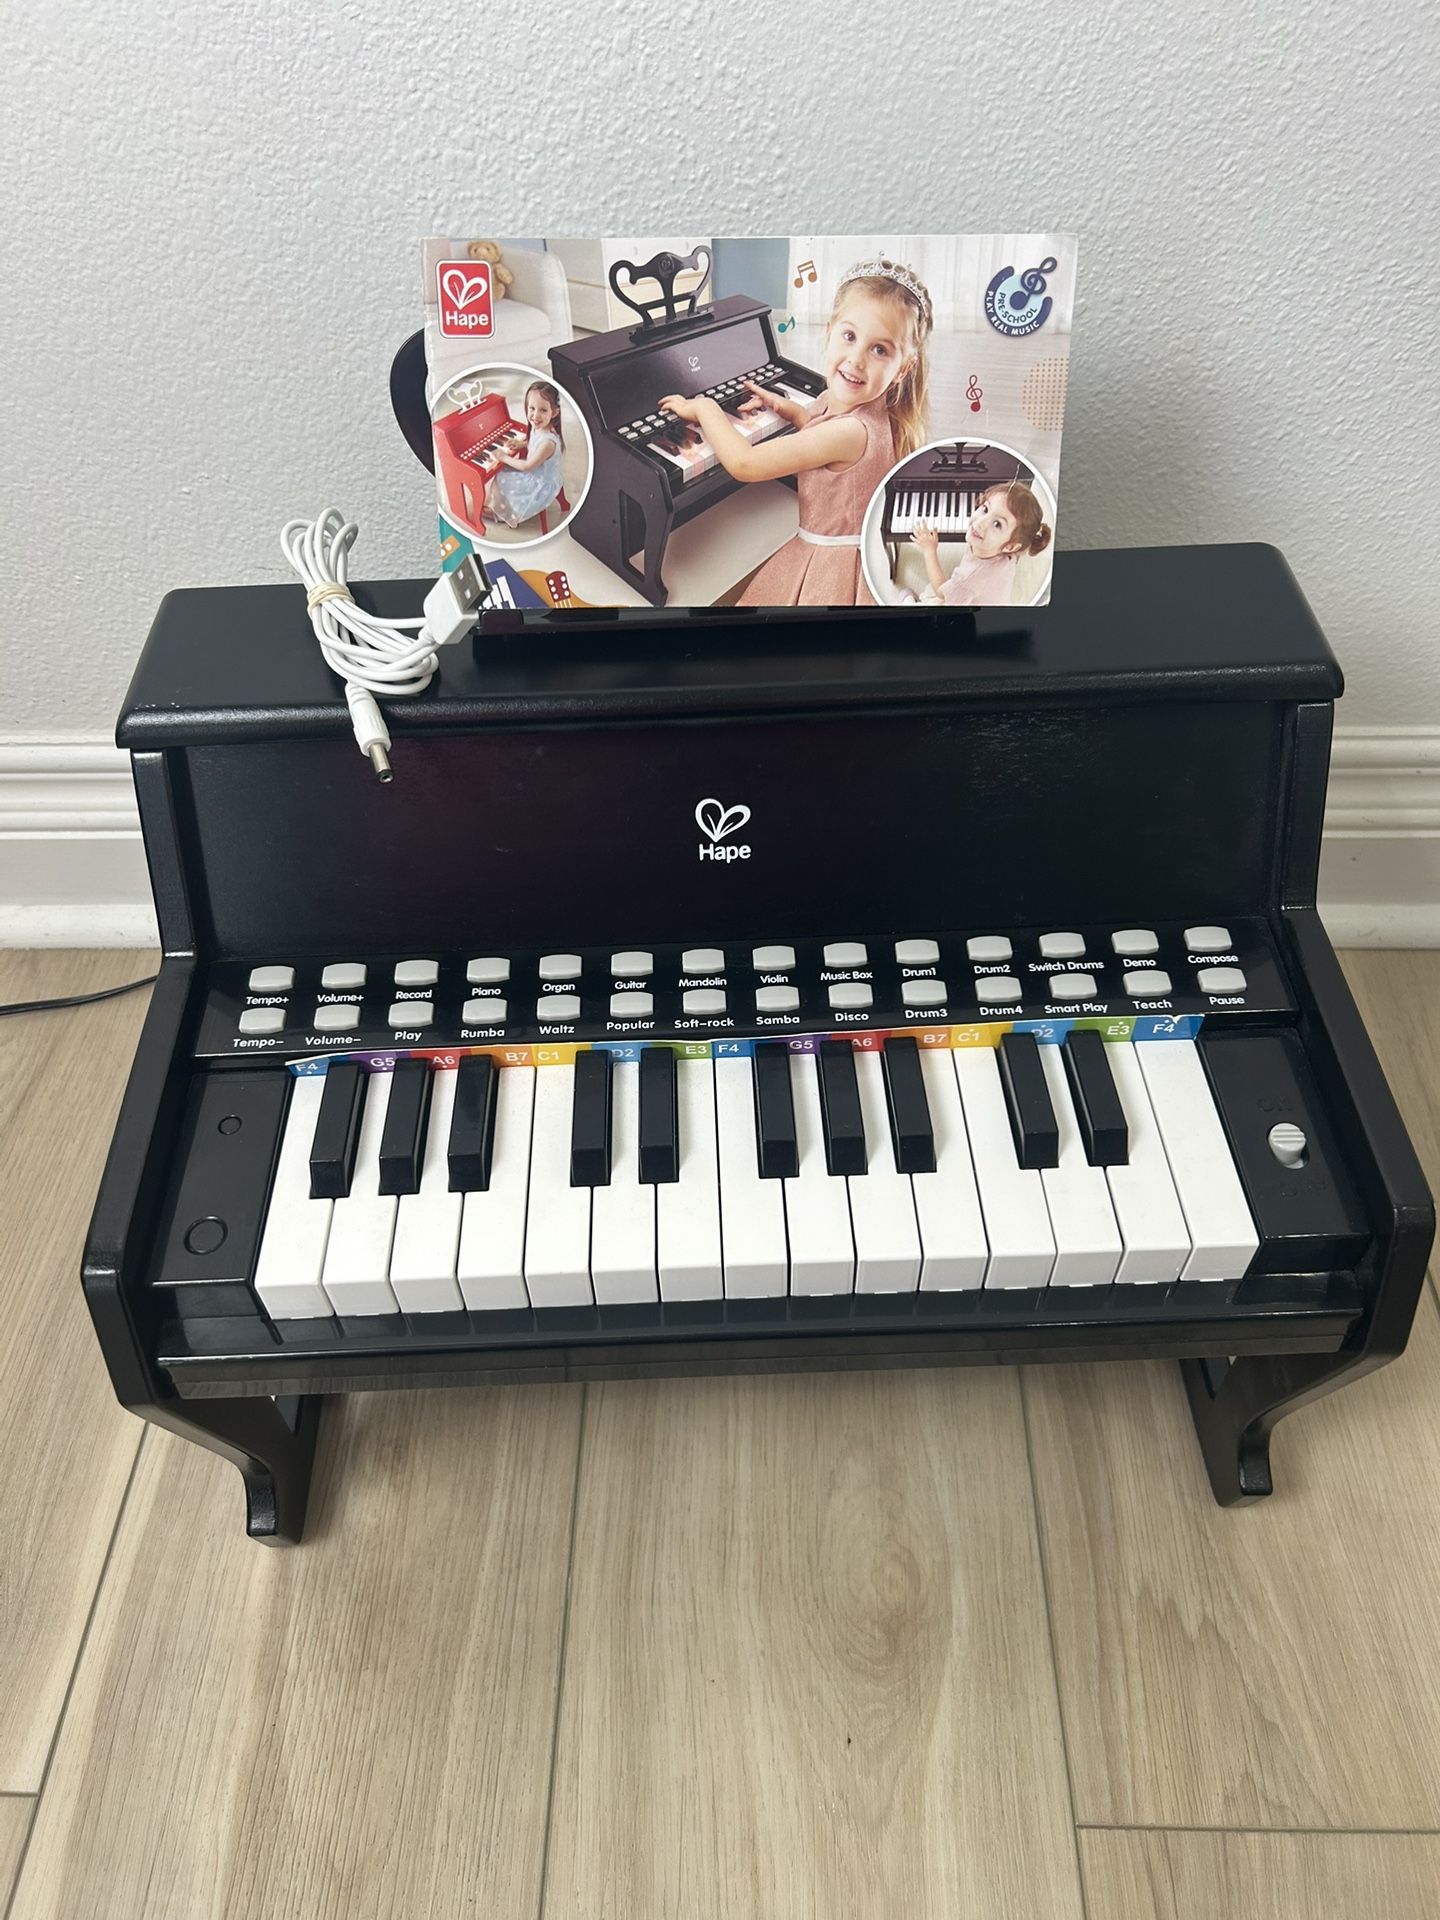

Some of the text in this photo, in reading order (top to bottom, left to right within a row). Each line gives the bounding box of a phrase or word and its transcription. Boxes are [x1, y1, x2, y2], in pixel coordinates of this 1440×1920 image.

[986, 290, 1040, 336] PLAY REAL MUSIC
[998, 292, 1037, 324] PRE-SCHOOL
[445, 311, 489, 329] Hape
[698, 843, 752, 864] Hape
[1123, 957, 1156, 968] Demo
[1187, 953, 1239, 965] Compose
[974, 964, 1011, 974] Drum2
[1028, 960, 1104, 972] Switch Drums
[820, 970, 873, 981] Music Box
[902, 967, 937, 977] Drum1
[678, 977, 727, 988] Mandolin
[760, 974, 789, 984] Violin
[542, 983, 575, 994] Organ
[614, 980, 647, 990] Guitar
[395, 989, 433, 999] Record
[471, 986, 501, 996] Piano
[246, 995, 290, 1006] Tempo+
[317, 993, 364, 1003] Volume+
[1209, 995, 1245, 1006] Pause
[1044, 1002, 1108, 1014] Smart Play
[1132, 999, 1173, 1010] Teach
[905, 1008, 948, 1019] Drum3
[979, 1005, 1023, 1016] Drum4
[674, 1017, 735, 1028] Soft-rock
[756, 1014, 800, 1025] Samba
[835, 1012, 869, 1022] Disco
[539, 1024, 575, 1035] Waltz
[606, 1020, 655, 1032] Popular
[1107, 1025, 1130, 1035] E3
[1152, 1023, 1175, 1034] F4
[395, 1031, 423, 1042] Play
[461, 1028, 505, 1039] Rumba
[957, 1032, 980, 1042] C1
[1031, 1028, 1054, 1038] D2
[852, 1037, 873, 1047] A6
[923, 1034, 948, 1044] B7
[685, 1045, 707, 1055] E3
[718, 1044, 739, 1053] F4
[789, 1040, 813, 1050] G5
[505, 1052, 529, 1062] B7
[537, 1051, 560, 1061] C1
[612, 1048, 635, 1058] D2
[370, 1057, 396, 1067] G5
[432, 1055, 455, 1065] A6
[295, 1062, 319, 1072] F4
